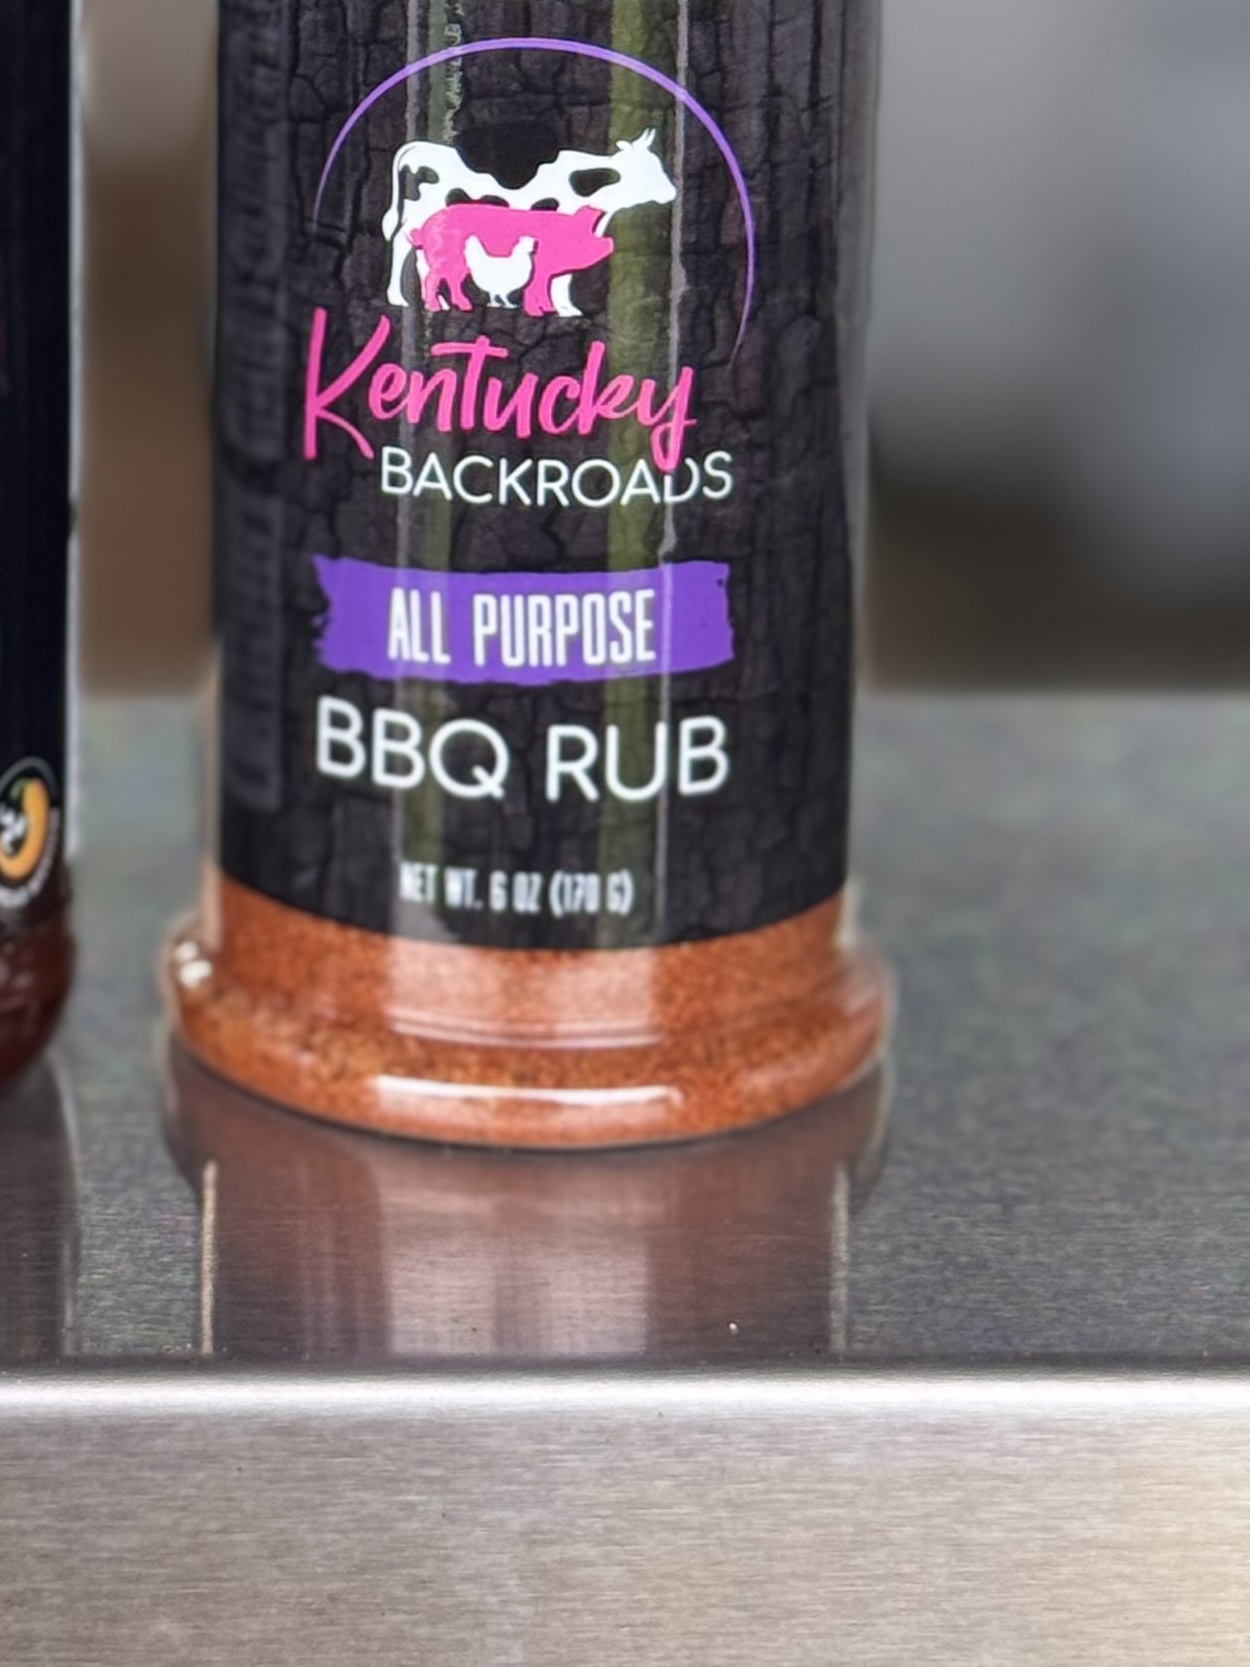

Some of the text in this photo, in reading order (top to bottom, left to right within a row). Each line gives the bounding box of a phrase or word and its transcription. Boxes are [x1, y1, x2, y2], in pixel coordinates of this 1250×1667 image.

[303, 307, 697, 474] Kentucky
[380, 445, 734, 508] BACKROADS
[387, 586, 656, 668] ALL PURPOSE
[316, 696, 730, 802] BBQ RUB
[400, 860, 634, 917] NET WT. 6 OZ (170 G)
